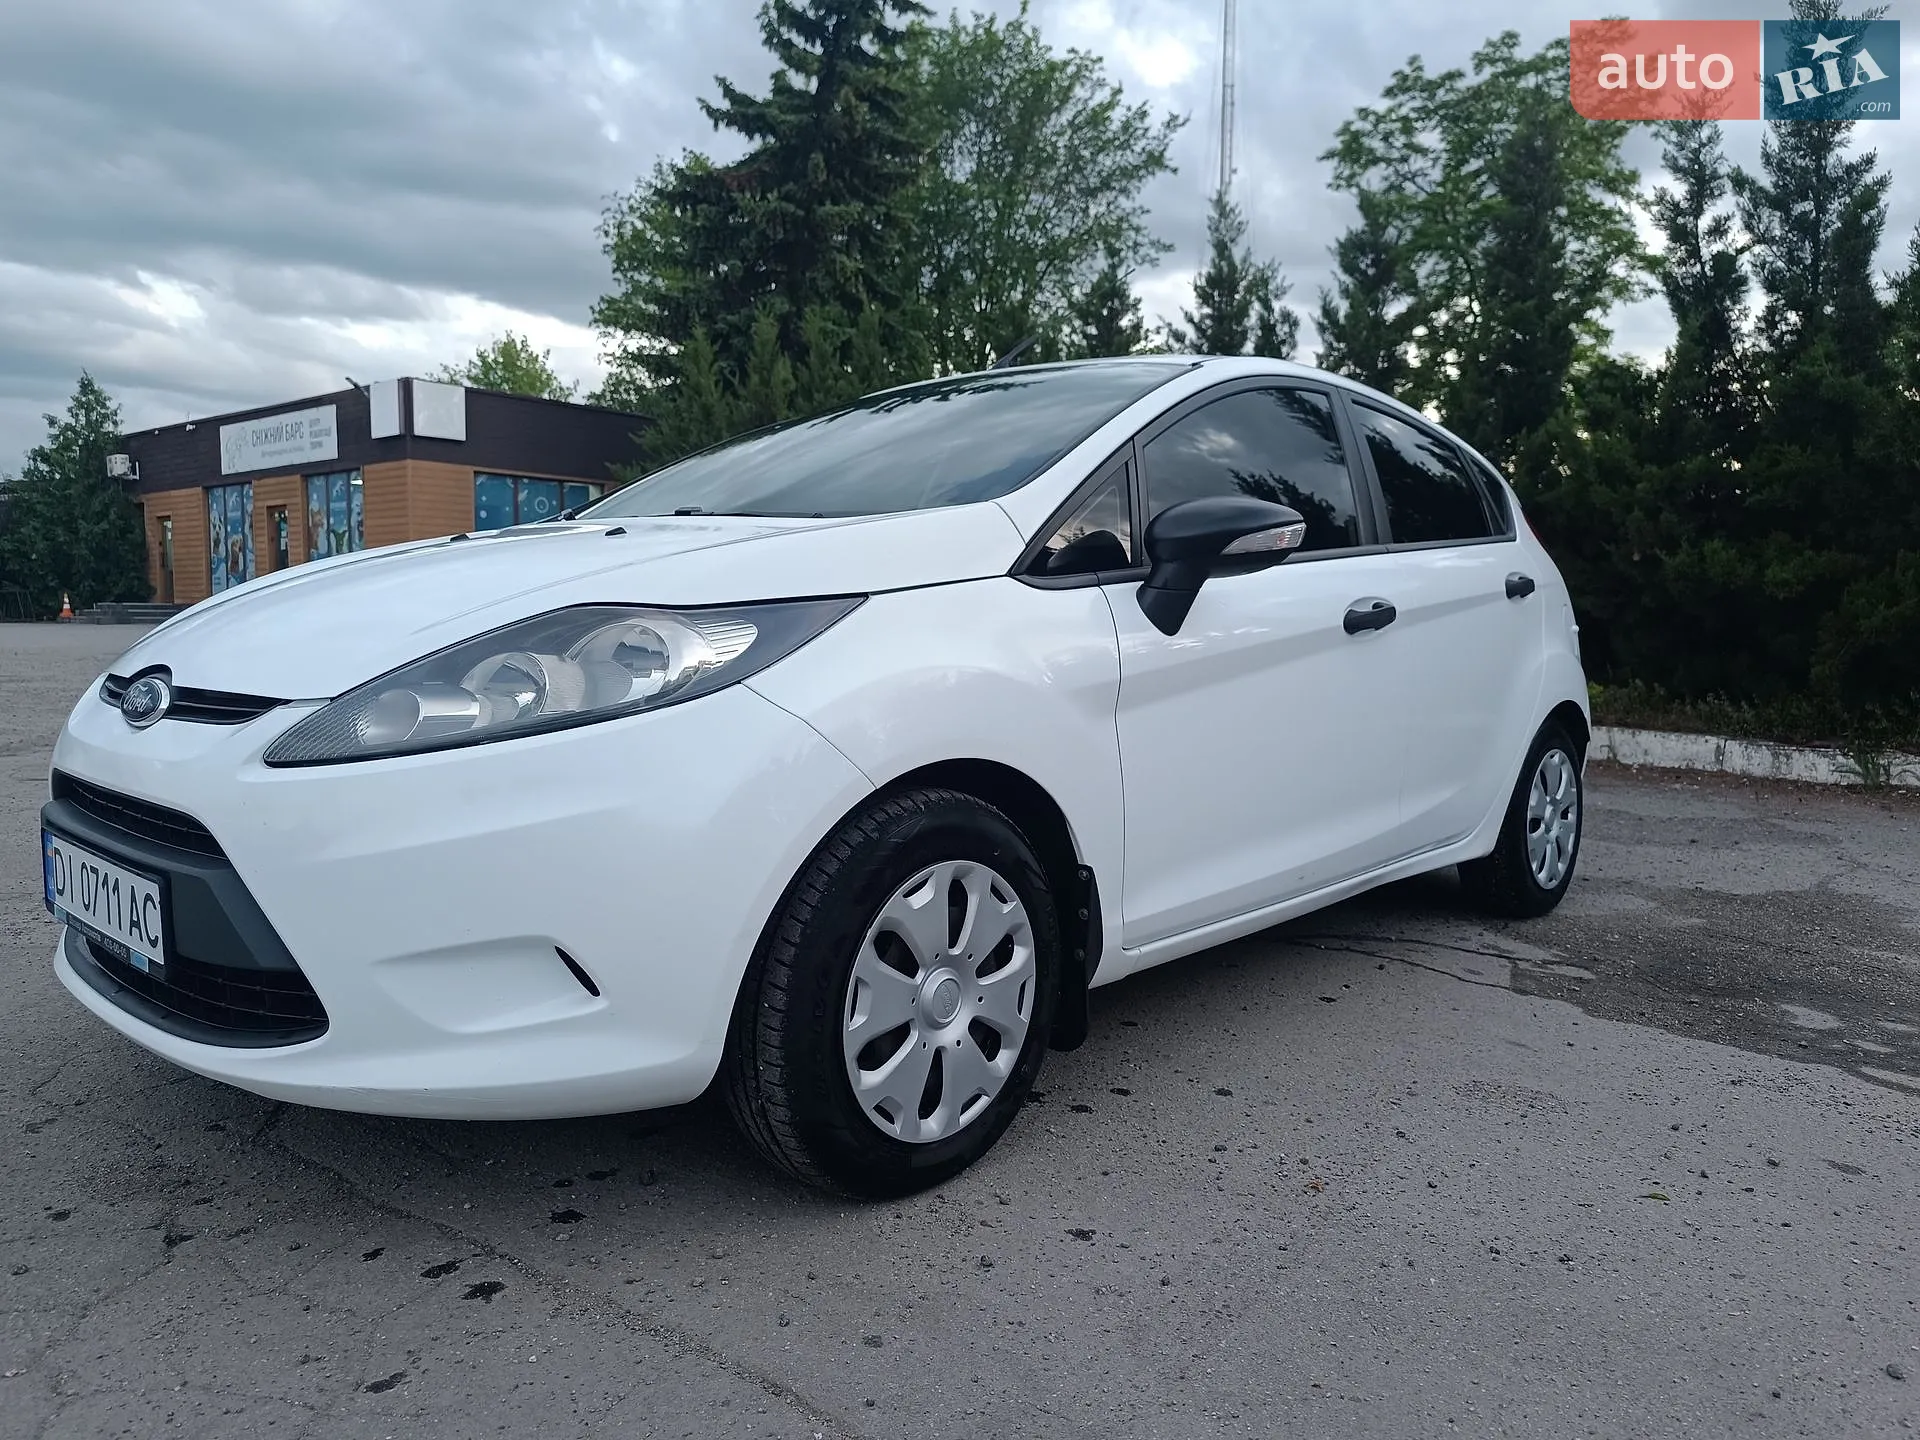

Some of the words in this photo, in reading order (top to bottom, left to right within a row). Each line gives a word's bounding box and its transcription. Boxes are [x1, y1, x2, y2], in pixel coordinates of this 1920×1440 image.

[251, 421, 285, 448] СНІЖНИЙ
[285, 420, 304, 442] БАРС
[123, 683, 152, 713] Ford
[53, 846, 74, 904] DI
[80, 861, 122, 932] 0711
[128, 885, 159, 949] AC
